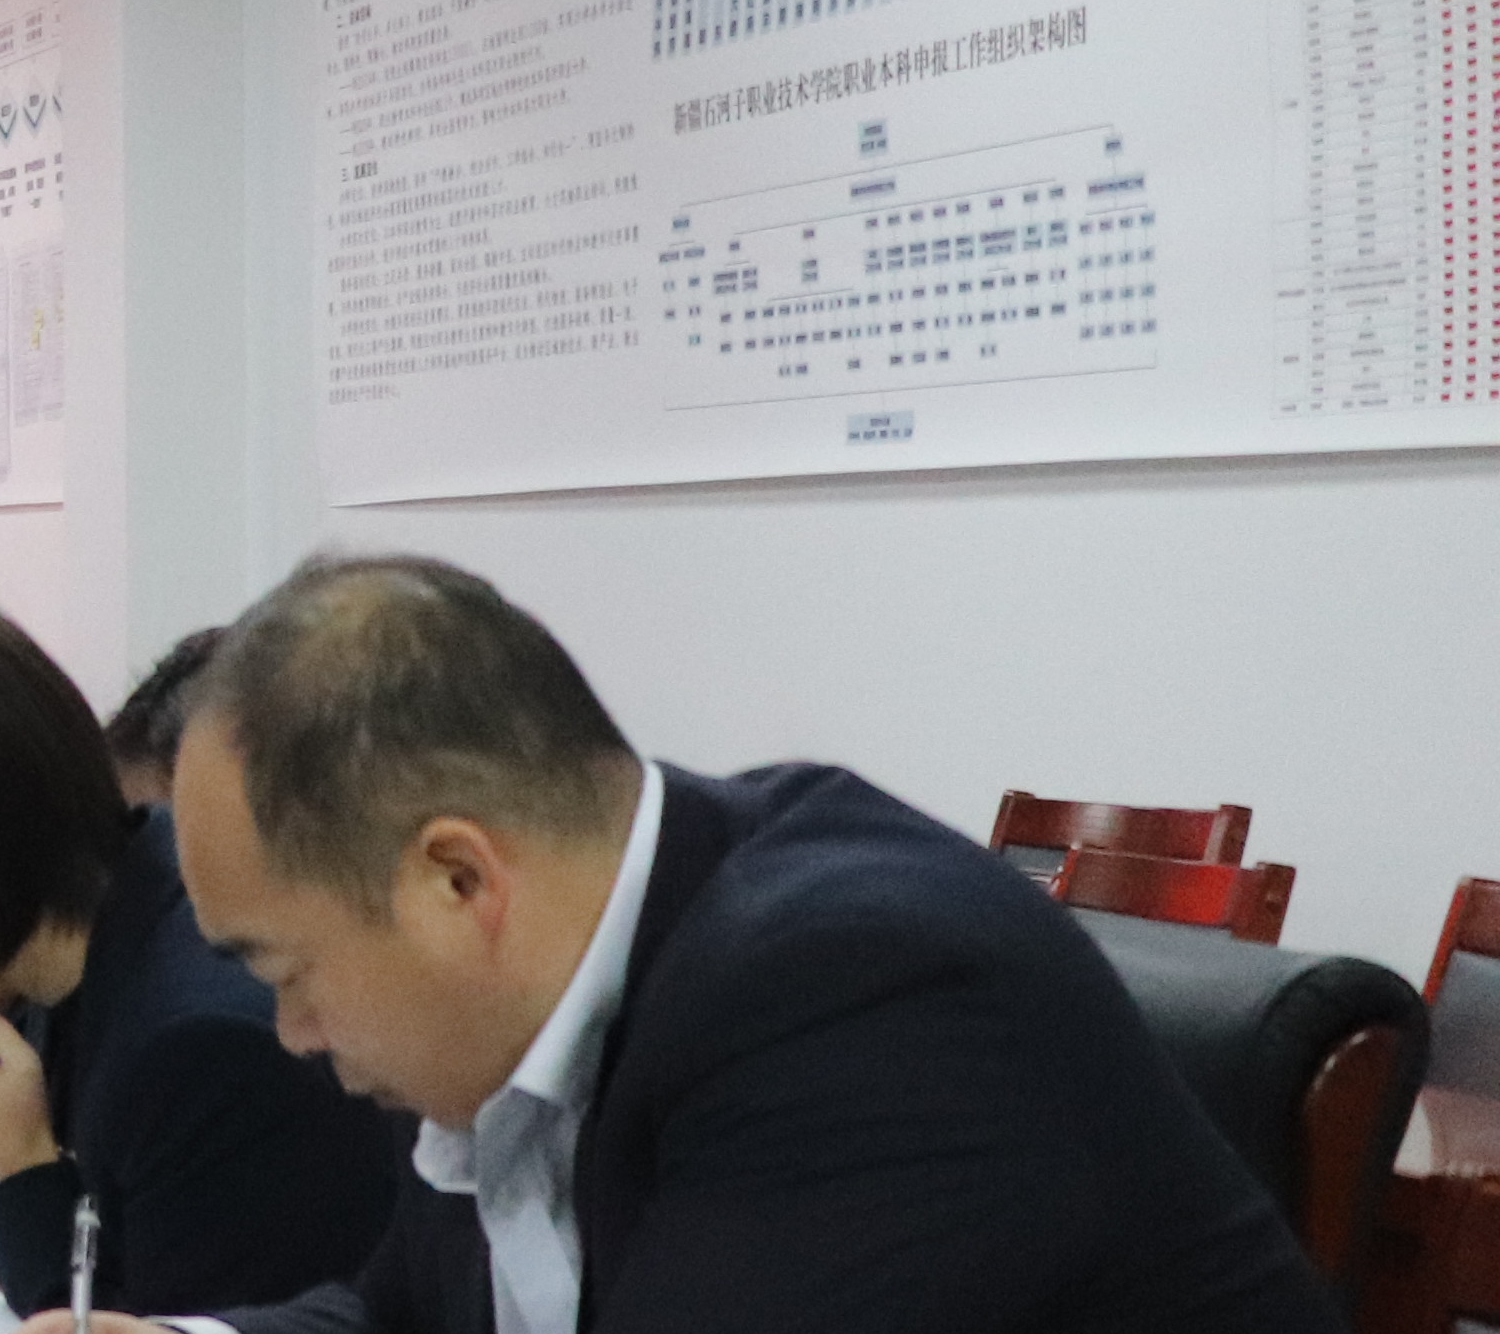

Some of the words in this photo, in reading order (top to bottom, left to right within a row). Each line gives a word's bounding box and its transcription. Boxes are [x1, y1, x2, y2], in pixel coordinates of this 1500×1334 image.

[673, 5, 1088, 136] 新疆石河子职业技术学院职业本科申报工作组织架构图
